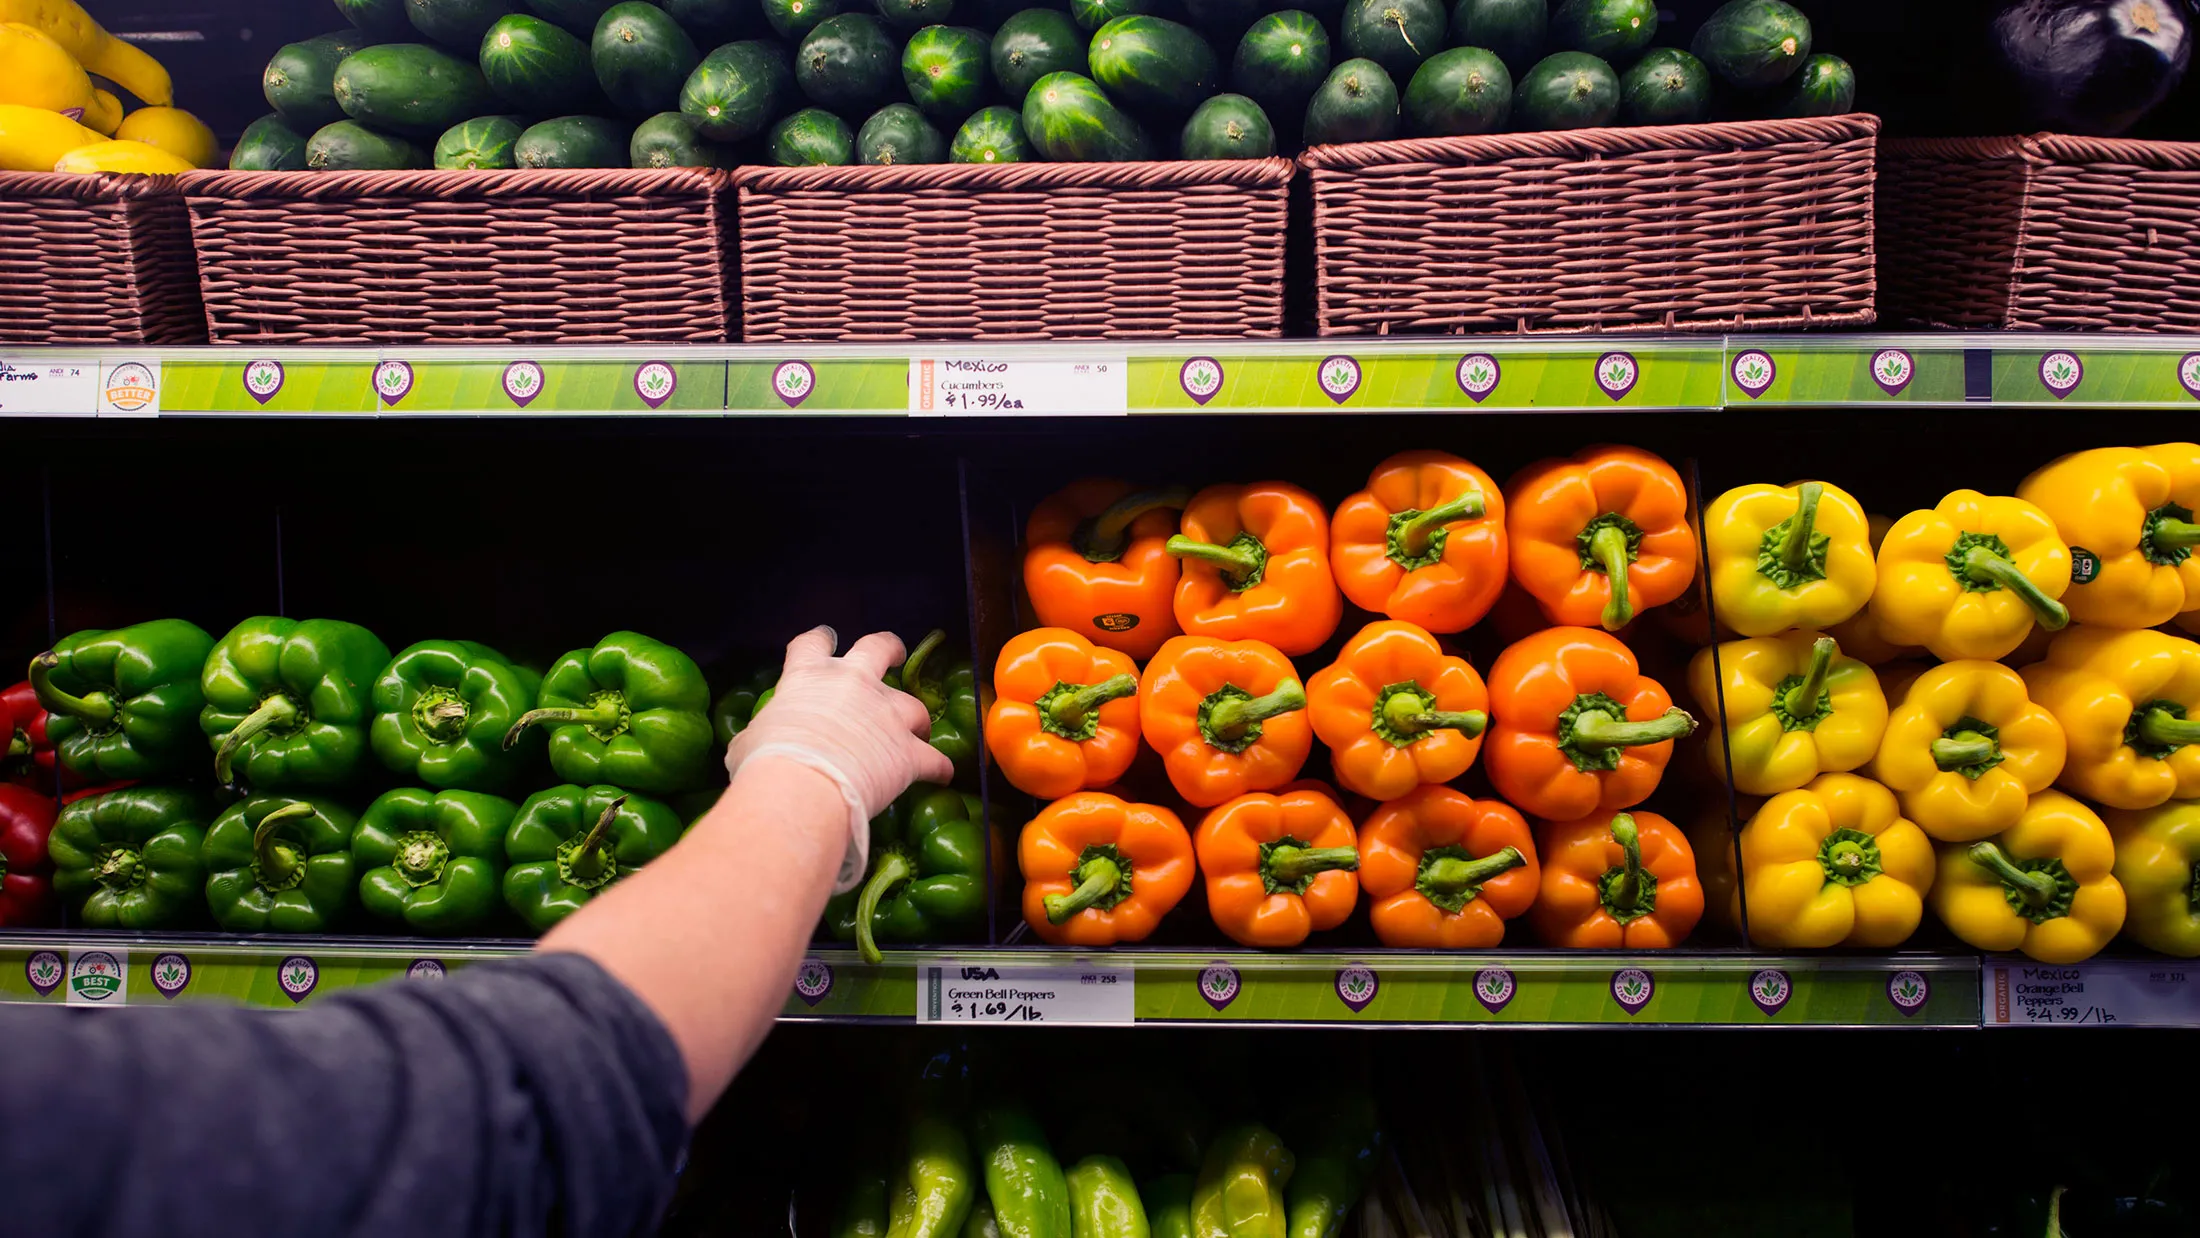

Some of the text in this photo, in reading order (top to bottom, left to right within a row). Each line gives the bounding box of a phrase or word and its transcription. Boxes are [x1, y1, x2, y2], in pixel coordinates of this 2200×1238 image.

[1605, 357, 1630, 365] HEALTH
[1741, 354, 1766, 363] HEALTH
[1880, 351, 1905, 360] HEALTH
[2049, 354, 2074, 363] HEALTH
[512, 365, 536, 373] HEALTH
[782, 364, 806, 373] HEALTH
[945, 360, 1008, 372] Mexico
[1097, 364, 1108, 372] 50
[1190, 361, 1215, 370] HEALTH
[1328, 360, 1353, 369] HEALTH
[1467, 358, 1491, 367] HEALTH
[644, 366, 668, 374] HEALTH
[1877, 367, 1908, 383] STARTS HERE
[249, 377, 278, 392] STARTS HERE
[1324, 376, 1355, 392] STARTS HERE
[1463, 374, 1494, 390] STARTS HERE
[1602, 372, 1632, 388] STARTS HERE
[1738, 370, 1769, 386] STARTS HERE
[2045, 370, 2076, 386] STARTS HERE
[508, 380, 538, 395] STARTS HERE
[640, 381, 670, 396] STARTS HERE
[779, 379, 809, 395] STARTS HERE
[923, 364, 931, 408] ORGANIC
[941, 380, 1004, 390] Cucumbers
[1187, 377, 1217, 393] STARTS HERE
[111, 390, 151, 400] BETTER
[35, 956, 57, 964] HEALTH
[160, 958, 183, 966] HEALTH
[287, 961, 310, 969] HEALTH
[32, 970, 59, 984] STARTS HERE
[157, 972, 185, 987] STARTS HERE
[961, 967, 1000, 980] USA
[1101, 975, 1117, 983] 258
[1621, 971, 1645, 979] HEALTH
[1759, 972, 1783, 980] HEALTH
[2022, 968, 2080, 980] Mexico
[83, 977, 111, 987] BEST
[284, 976, 312, 990] STARTS HERE
[948, 988, 1055, 1001] Green Bell Peppers
[1204, 982, 1234, 998] STARTS HERE
[1342, 984, 1372, 999] STARTS HERE
[1480, 985, 1510, 1001] STARTS HERE
[1617, 986, 1648, 1002] STARTS HERE
[1755, 987, 1785, 1003] STARTS HERE
[2016, 982, 2084, 996] Orange Bell
[1894, 988, 1923, 1004] STARTS HERE
[2017, 995, 2064, 1007] Peppers
